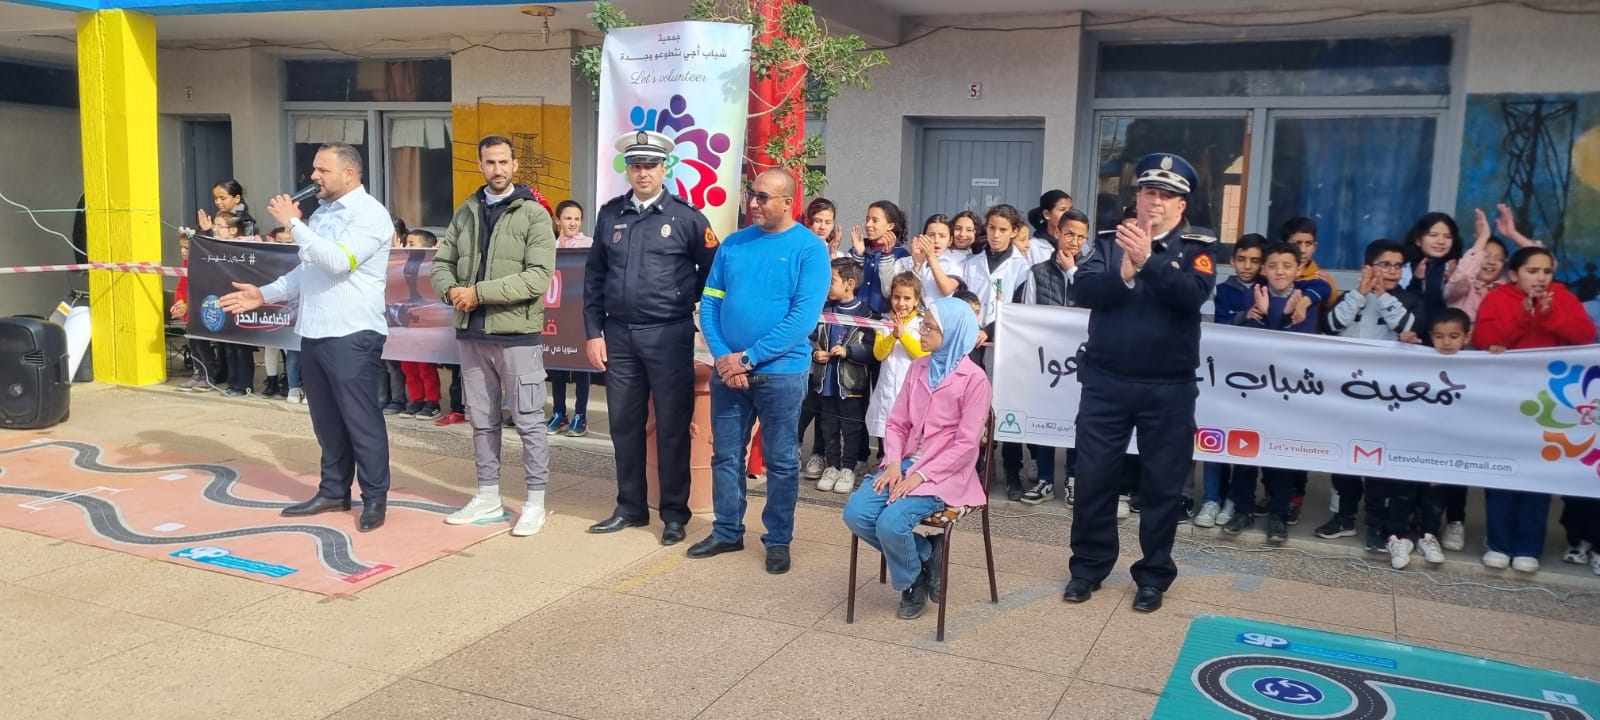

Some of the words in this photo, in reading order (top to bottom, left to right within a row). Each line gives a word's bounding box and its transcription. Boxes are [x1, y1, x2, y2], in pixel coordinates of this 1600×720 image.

[658, 34, 681, 45] جمعية
[683, 45, 701, 62] أجي
[702, 50, 727, 61] شباب
[631, 71, 657, 85] Let's
[658, 69, 706, 84] volunteer
[970, 84, 977, 97] 5
[235, 310, 258, 327] الحذر
[1225, 363, 1324, 400] شباب
[1340, 369, 1466, 412] جمعية
[1269, 443, 1288, 451] Let's
[1290, 445, 1329, 455] volunteer
[1388, 453, 1513, 472] Letsvolunteer1@gmail.com
